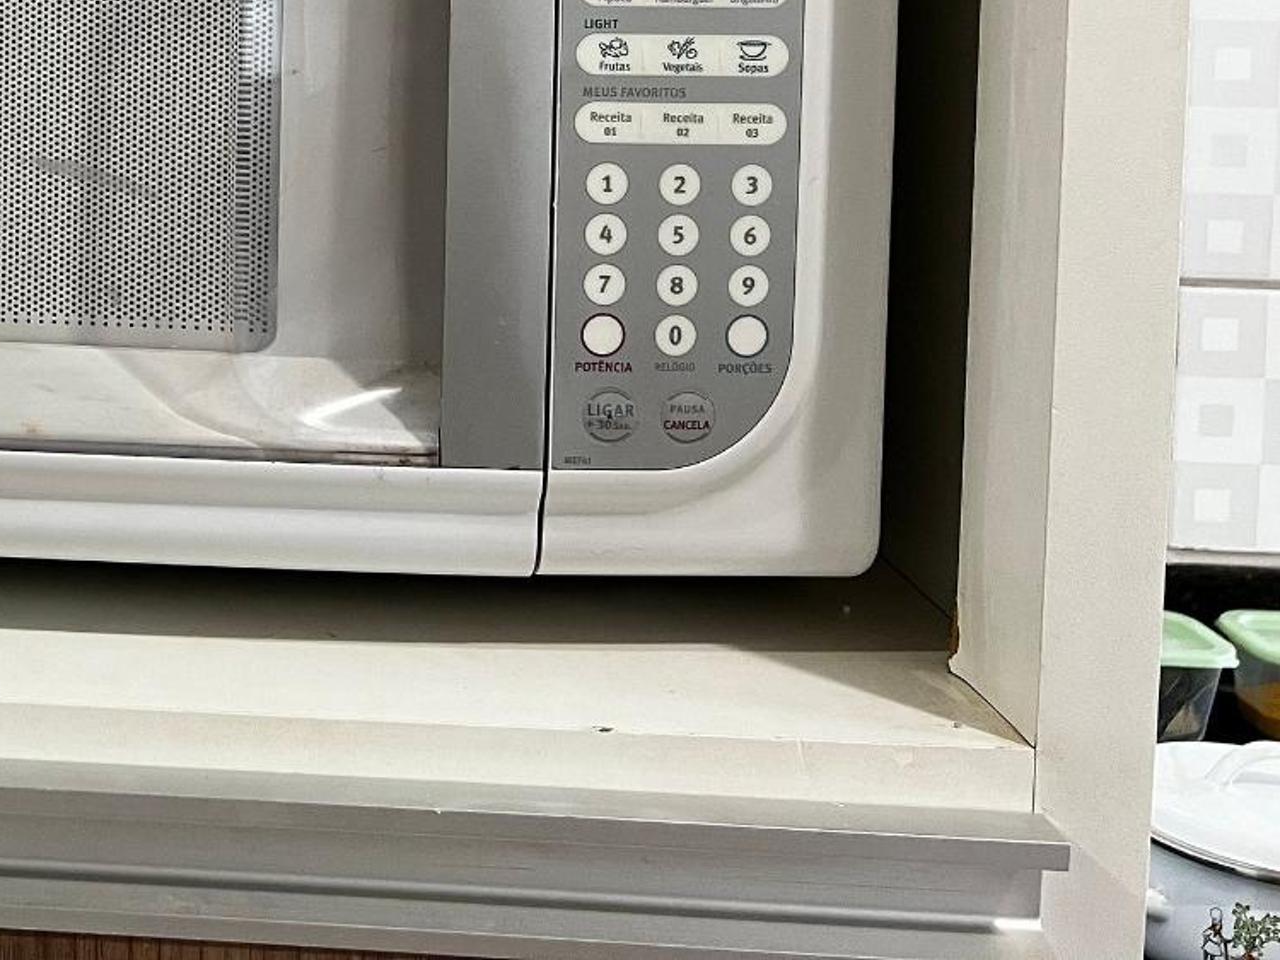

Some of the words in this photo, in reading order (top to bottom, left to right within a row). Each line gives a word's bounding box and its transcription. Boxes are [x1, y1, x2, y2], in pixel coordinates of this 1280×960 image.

[584, 19, 619, 30] LIGHT
[599, 61, 631, 72] Frutas
[663, 62, 703, 75] Vegetais
[738, 63, 769, 75] Sopas
[583, 88, 617, 98] MEUS
[621, 88, 687, 99] FAVORITOS
[590, 111, 632, 123] Receita
[663, 113, 704, 124] Receita
[732, 113, 773, 125] Receita
[604, 126, 617, 137] 01
[676, 128, 690, 138] 02
[745, 128, 759, 139] 03
[601, 175, 613, 193] 1
[673, 176, 687, 194] 2
[745, 176, 759, 195] 3
[599, 225, 613, 244] 4
[672, 226, 685, 244] 5
[743, 227, 757, 246] 6
[598, 275, 611, 293] 7
[669, 277, 684, 295] 8
[741, 277, 756, 296] 9
[669, 325, 682, 346] 0
[575, 361, 632, 373] POTÊNCIA
[654, 361, 696, 372] RELÓGIO
[718, 362, 772, 375] PORÇÕES
[587, 403, 634, 417] LIGAR
[670, 405, 705, 414] PAUSA
[663, 420, 710, 430] CANCELA
